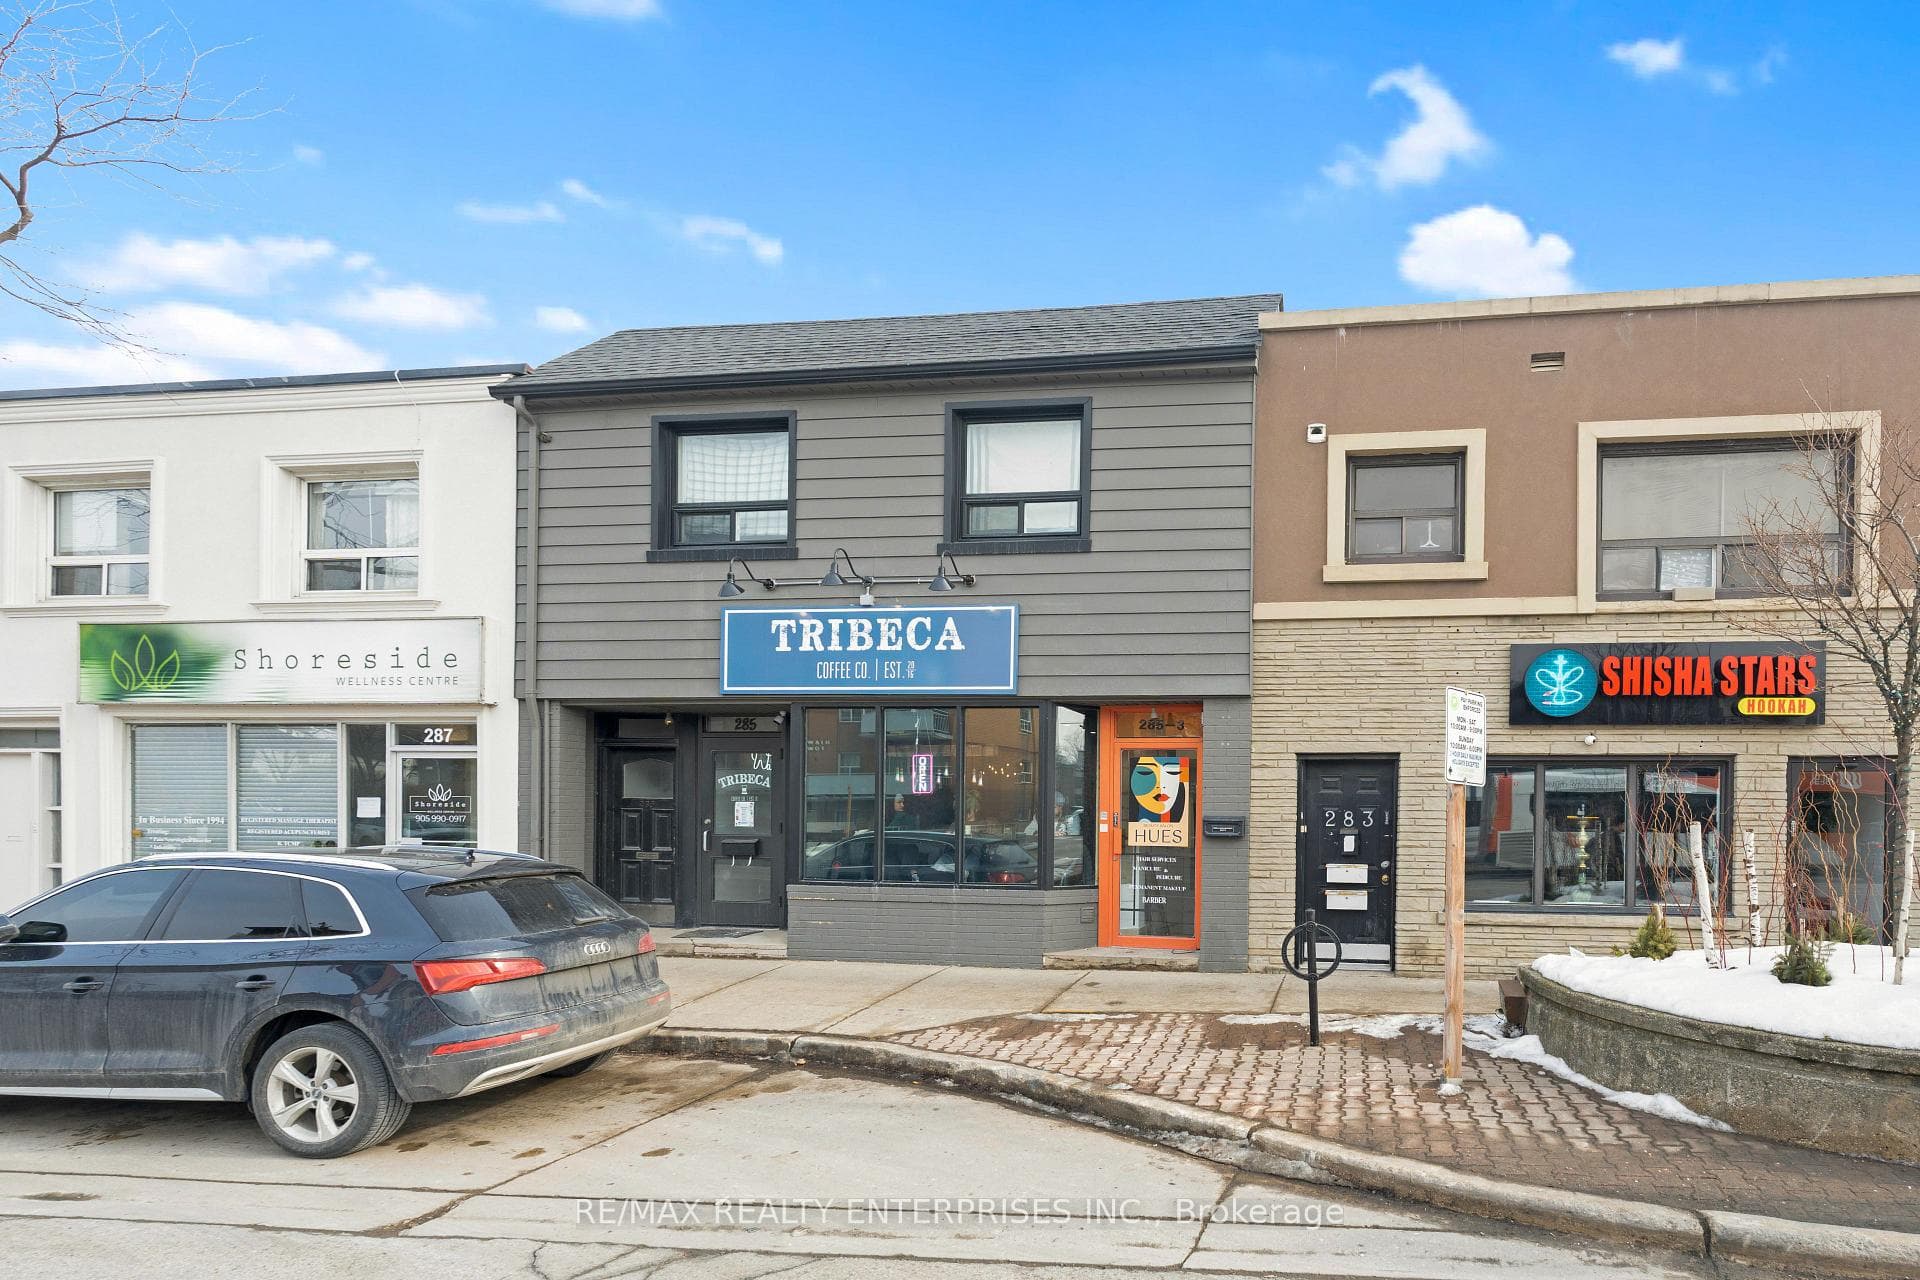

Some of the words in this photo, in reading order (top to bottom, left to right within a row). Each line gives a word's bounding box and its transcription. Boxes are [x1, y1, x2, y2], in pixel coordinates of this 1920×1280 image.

[771, 616, 966, 652] TRIBECA
[234, 646, 458, 670] Shoreside
[816, 661, 851, 679] COFFEE
[854, 661, 871, 679] CO.
[884, 661, 905, 679] EST.
[1602, 655, 1713, 697] SHISHA
[1720, 655, 1817, 696] STARS
[336, 676, 402, 686] WELLNESS
[408, 676, 459, 686] CENTRE
[1746, 698, 1808, 714] HOOKAH
[735, 718, 757, 731] 285
[423, 728, 454, 743] 287
[718, 774, 771, 788] TRIBECA
[919, 756, 927, 791] OPEN
[138, 815, 147, 824] In
[149, 815, 182, 825] Business
[183, 816, 205, 825] Since
[206, 816, 225, 825] 1994
[415, 814, 430, 823] 905
[1325, 811, 1374, 827] 283
[1135, 829, 1183, 844] HUES
[1142, 896, 1167, 904] BARBER
